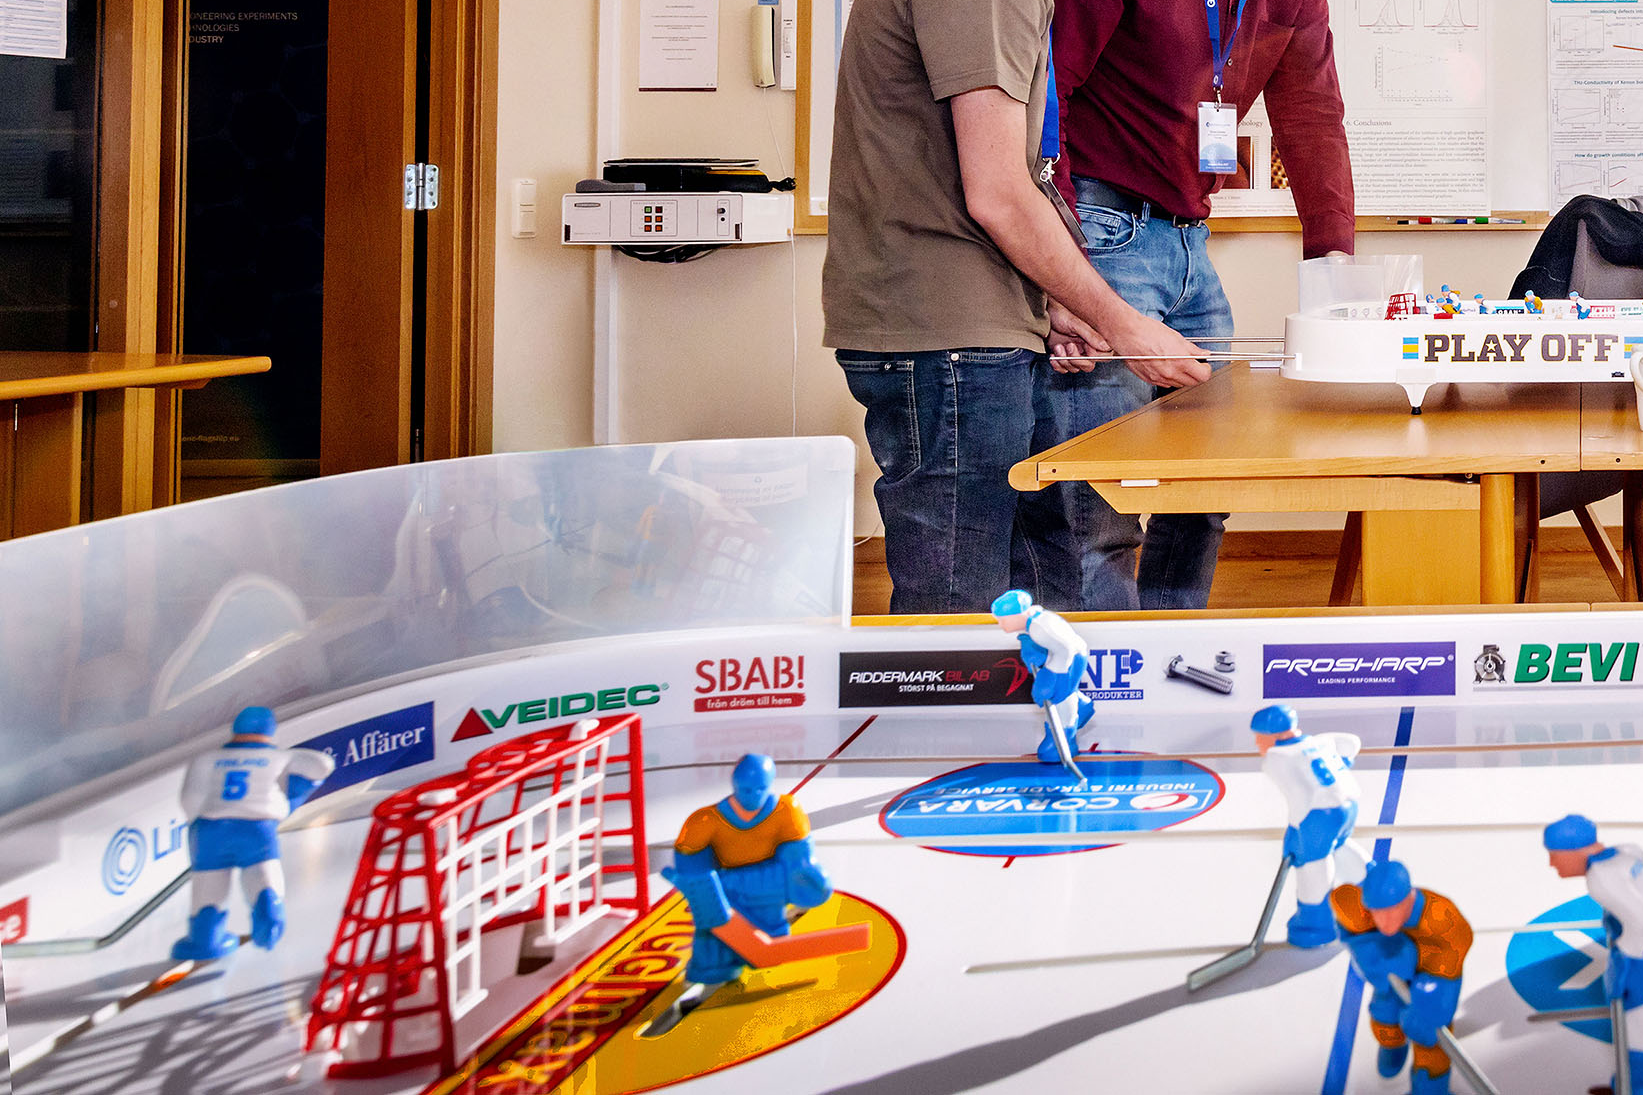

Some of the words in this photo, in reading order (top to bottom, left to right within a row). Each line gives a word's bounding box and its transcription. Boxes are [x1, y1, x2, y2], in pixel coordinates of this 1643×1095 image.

[190, 12, 236, 21] ONEERING
[238, 12, 299, 21] EXPERIMENTS
[189, 35, 225, 44] DUSTRY
[1424, 334, 1532, 362] PLAY
[1541, 334, 1619, 362] OFF
[1265, 656, 1446, 675] PROSHARP
[1513, 642, 1640, 683] BEVI
[694, 655, 805, 694] SBAB!
[849, 669, 943, 684] RIDDERMARK
[945, 670, 968, 682] BIL
[969, 669, 991, 681] AB
[1356, 676, 1396, 684] PERFORMANCE
[899, 684, 924, 693] STÖRST
[926, 682, 936, 692] PÅ
[937, 683, 974, 692] BEGAGNAT
[482, 684, 660, 729] VEIDEC
[706, 698, 728, 709] från
[729, 697, 756, 708] dröm
[757, 695, 770, 706] till
[772, 694, 792, 706] hem
[343, 723, 426, 767] Affärer
[223, 771, 251, 801] 5
[918, 797, 1119, 813] CORVARA
